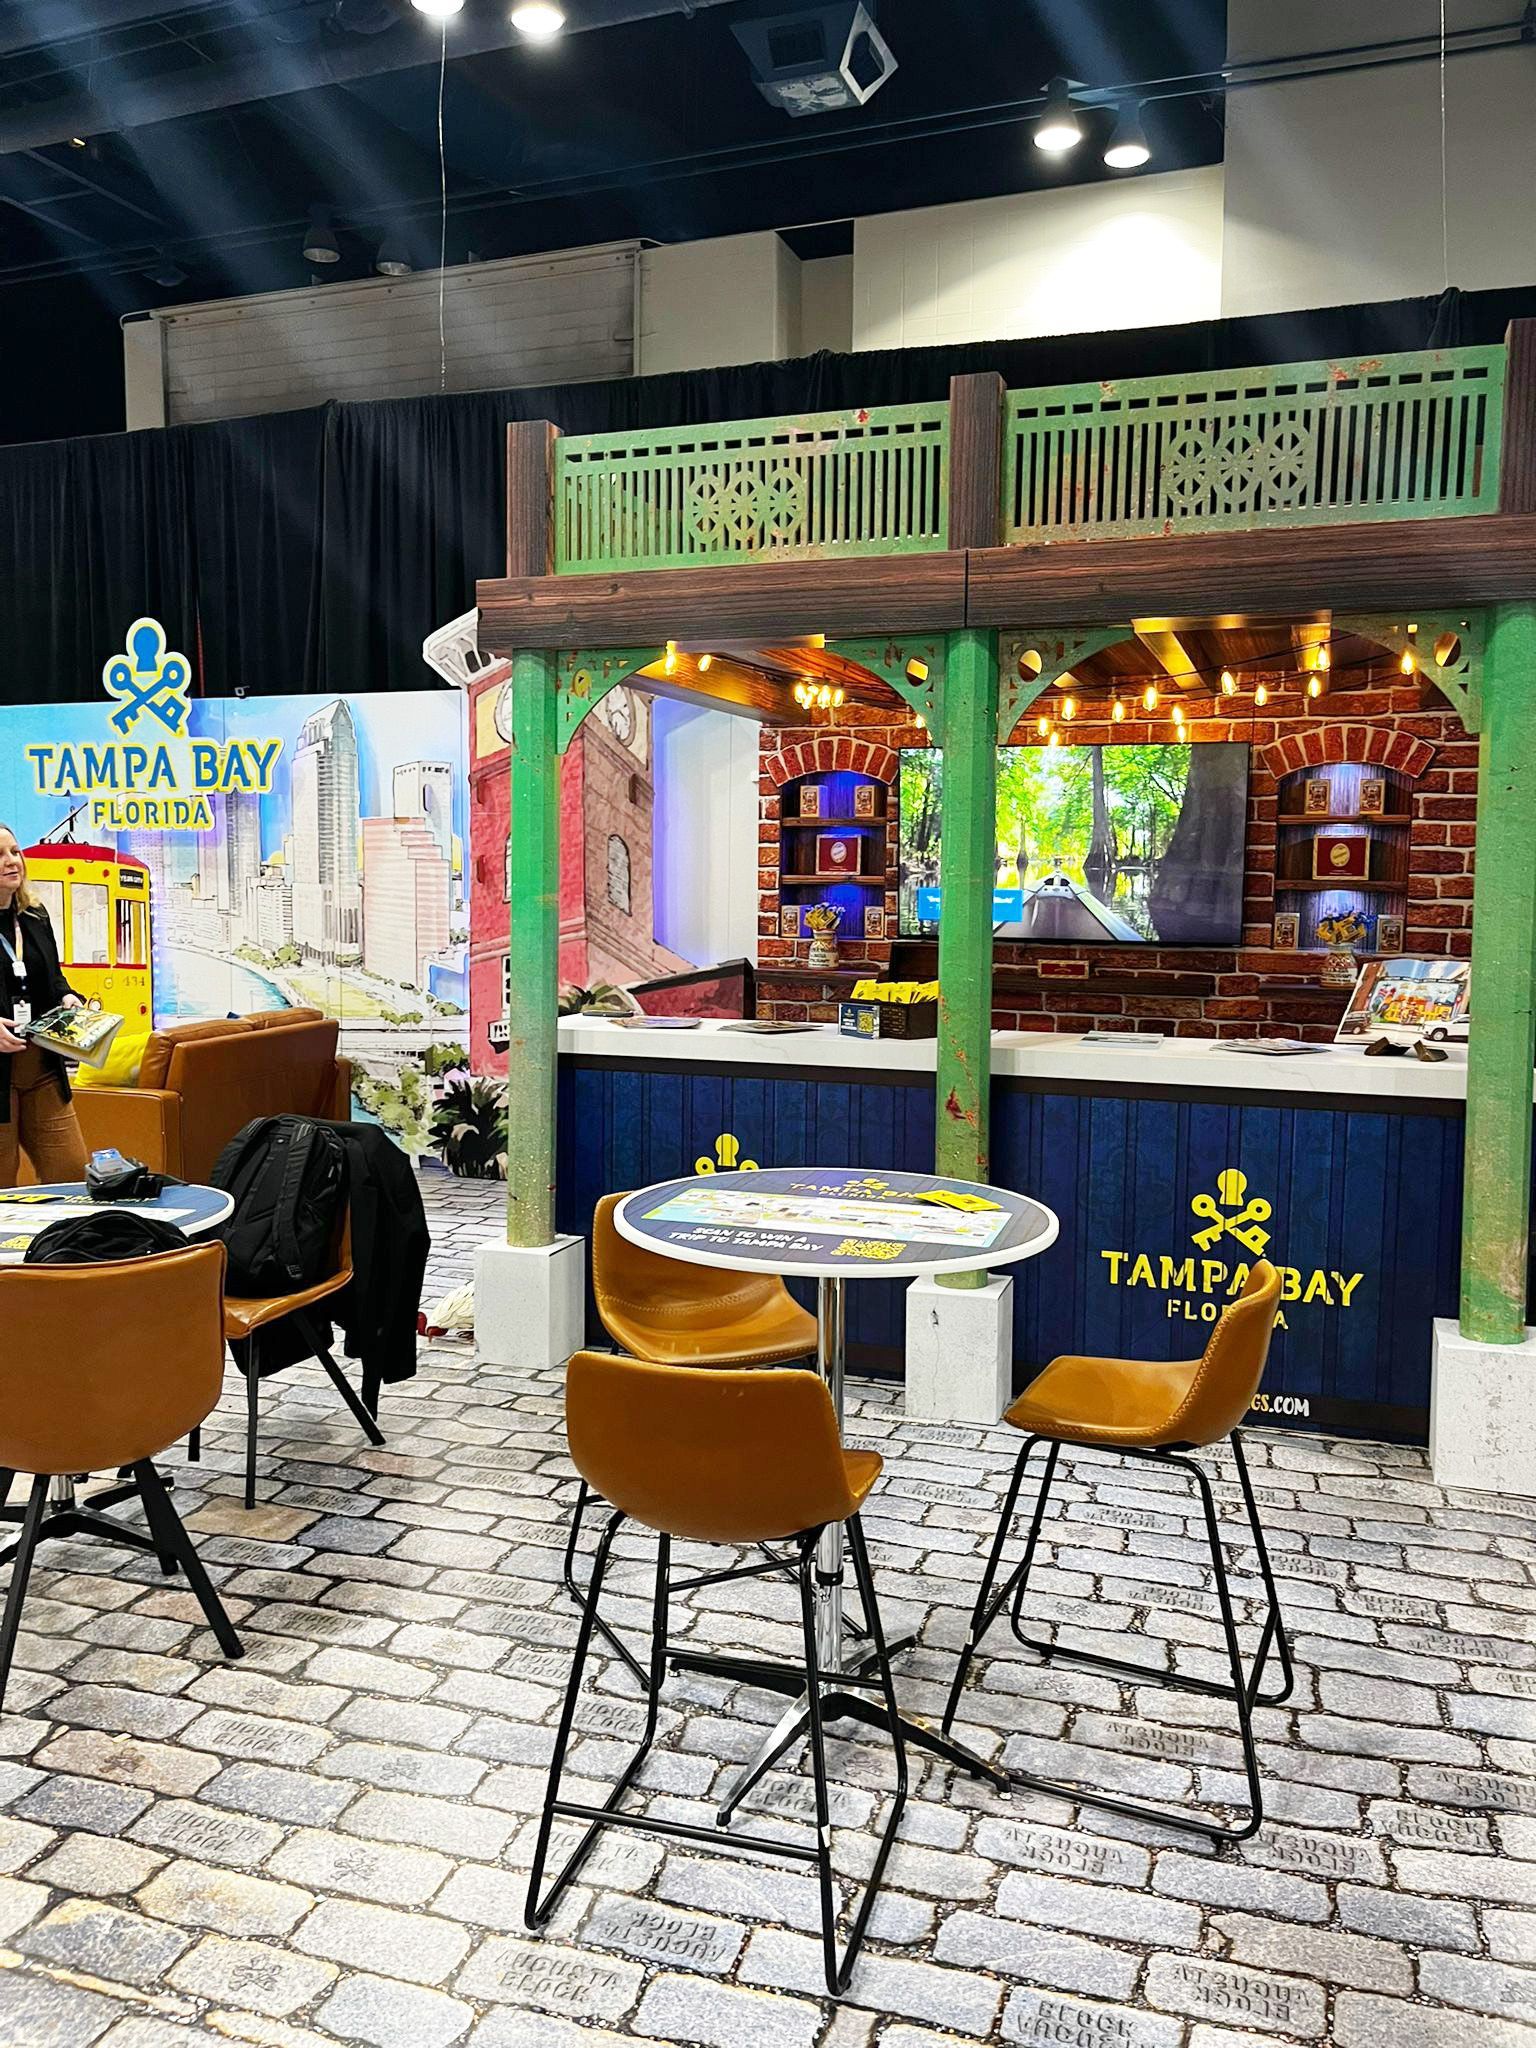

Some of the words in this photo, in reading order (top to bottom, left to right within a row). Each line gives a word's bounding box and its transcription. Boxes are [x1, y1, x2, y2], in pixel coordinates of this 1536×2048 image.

[30, 746, 176, 788] TAMPA
[192, 743, 278, 788] BAY
[94, 801, 209, 825] FLORIDA
[668, 1232, 707, 1241] TRIP
[732, 1237, 786, 1248] TAMPA
[788, 1243, 824, 1251] BAY
[693, 1227, 734, 1236] SCAN
[734, 1231, 756, 1239] TO
[760, 1233, 794, 1242] WIN
[1275, 1266, 1364, 1307] BAY
